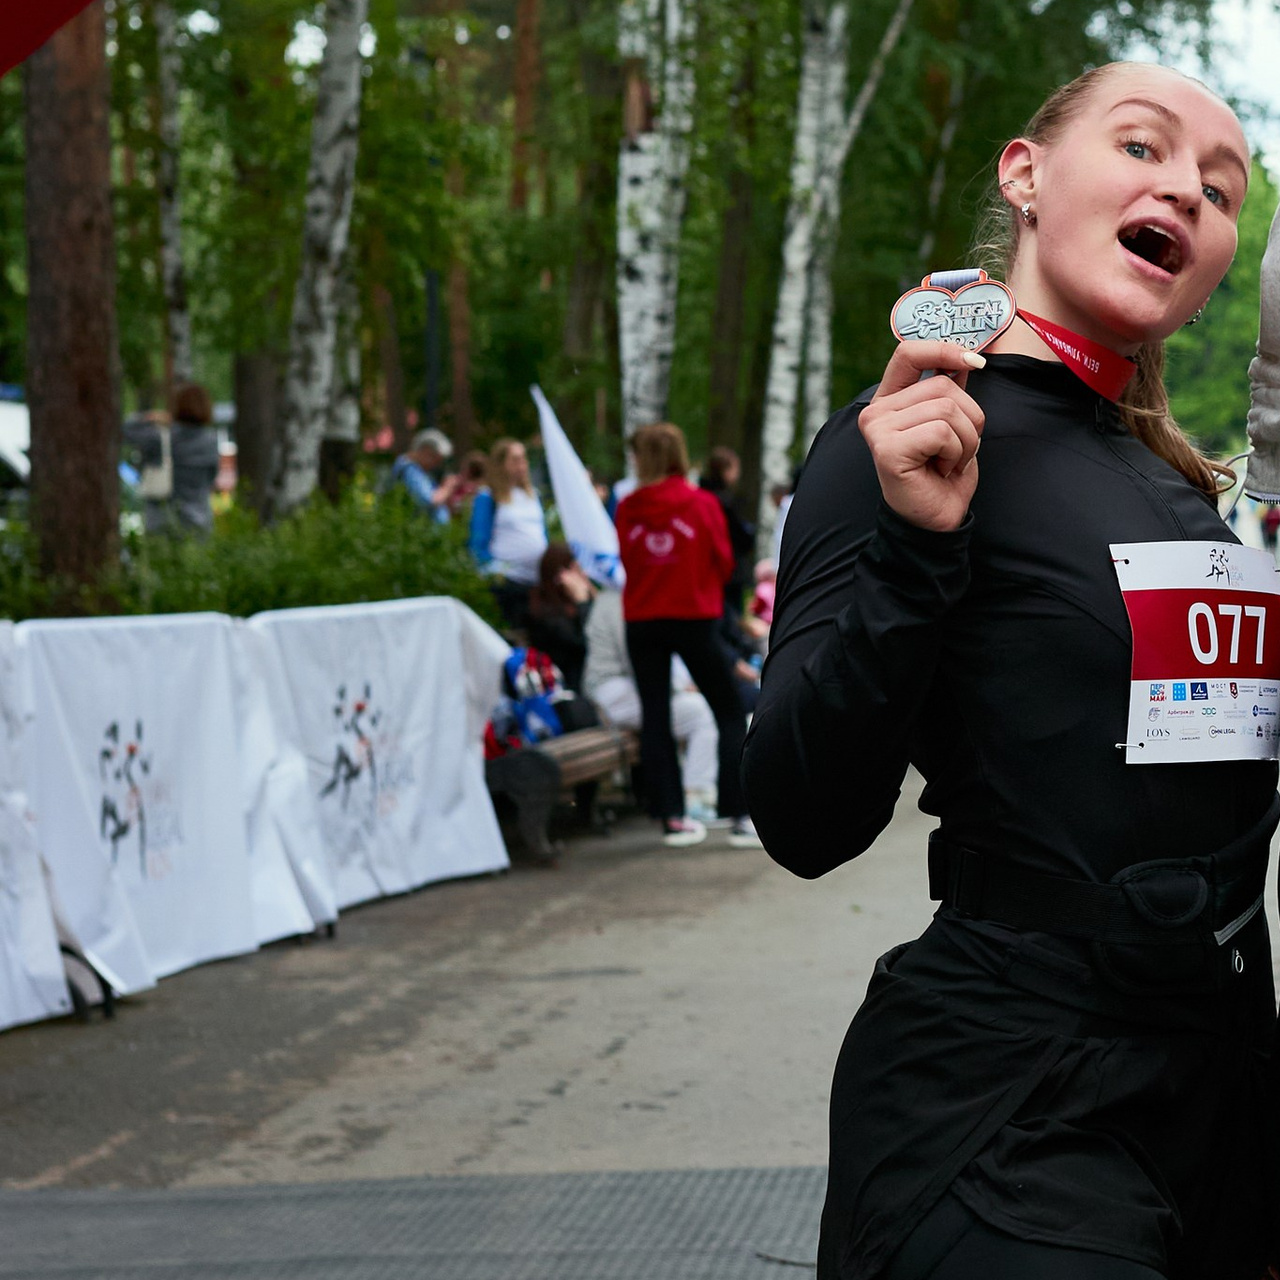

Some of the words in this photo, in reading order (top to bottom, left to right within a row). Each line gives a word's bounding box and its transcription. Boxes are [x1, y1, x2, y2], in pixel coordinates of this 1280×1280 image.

[955, 300, 1003, 319] LEGAL
[952, 315, 1000, 332] RUN
[932, 334, 979, 350] 26
[1187, 602, 1267, 665] 077
